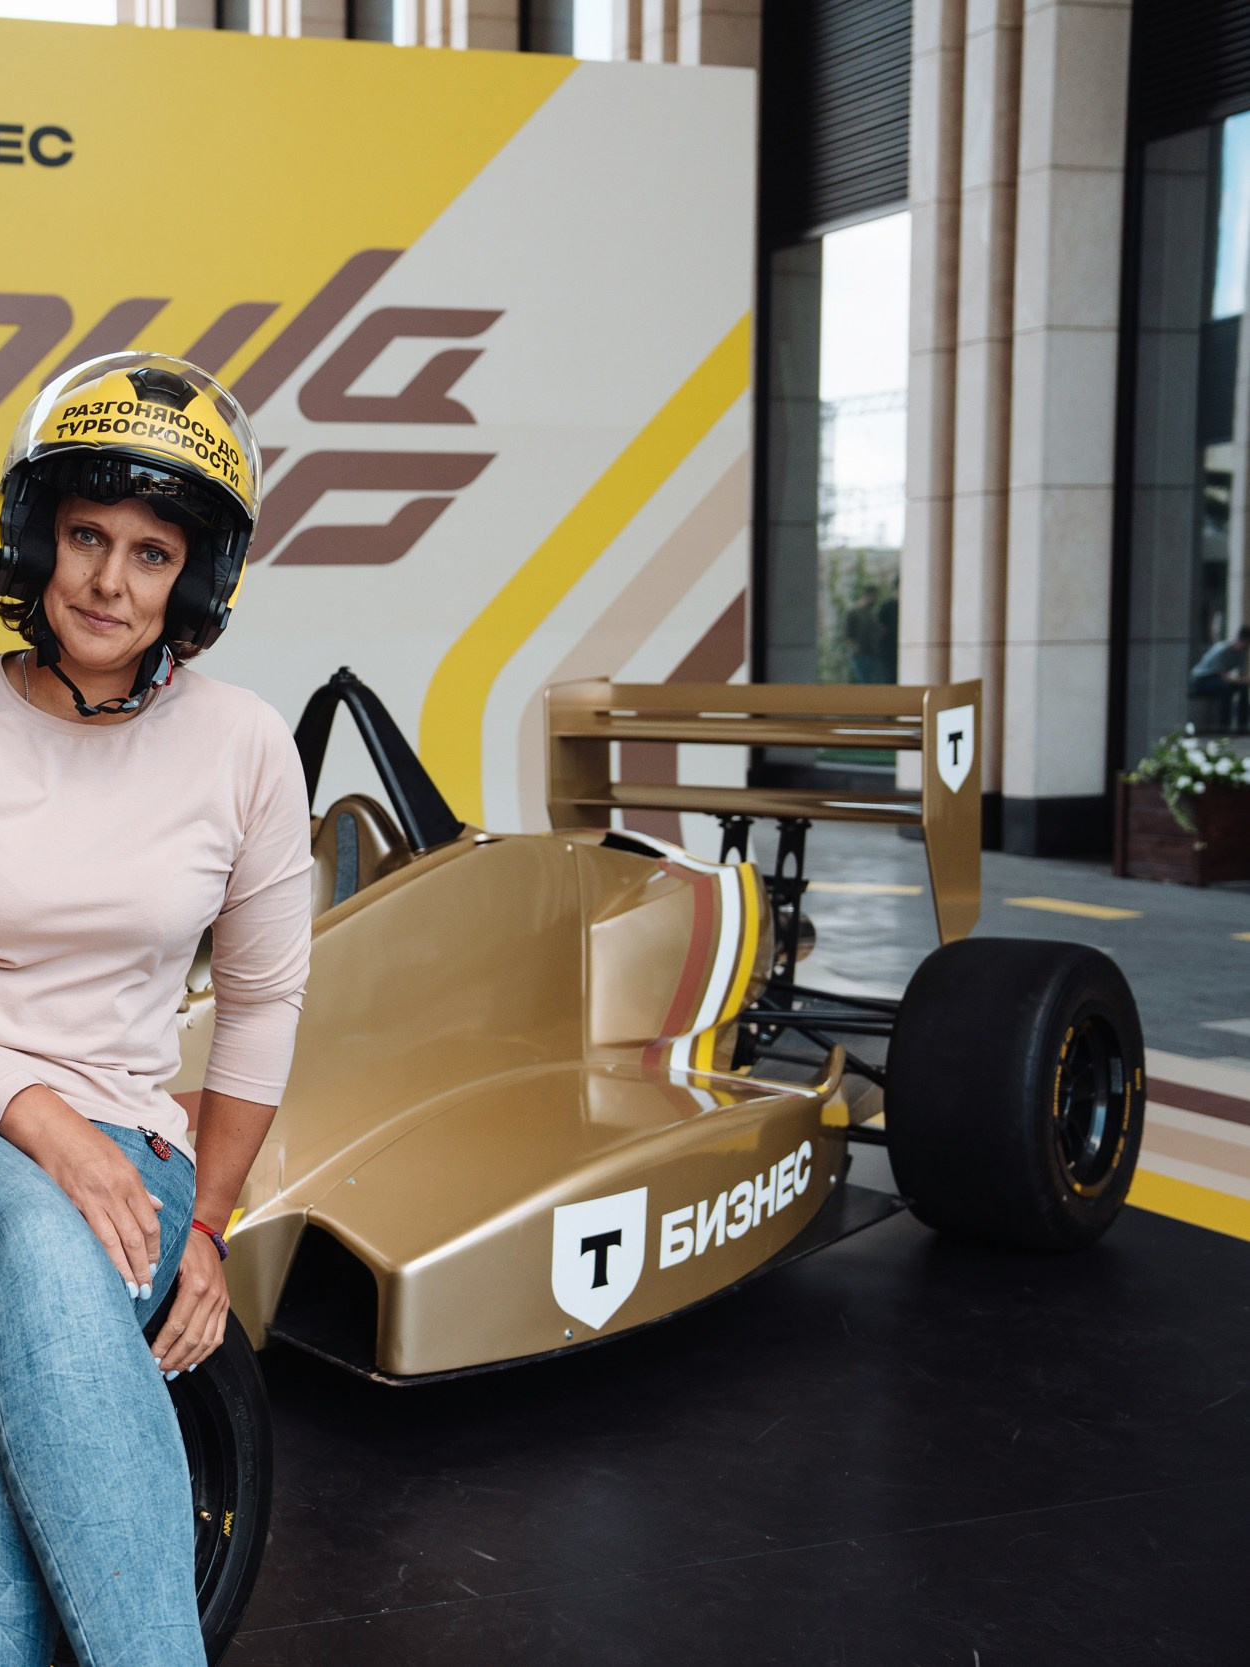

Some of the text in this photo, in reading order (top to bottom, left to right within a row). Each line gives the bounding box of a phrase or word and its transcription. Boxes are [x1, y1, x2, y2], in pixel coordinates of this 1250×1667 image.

[56, 418, 241, 489] ТУРБОСКОРОСТИ
[62, 401, 240, 466] РАЗГОНЯЮСЬ ДО
[659, 1140, 812, 1270] БИЗНЕС
